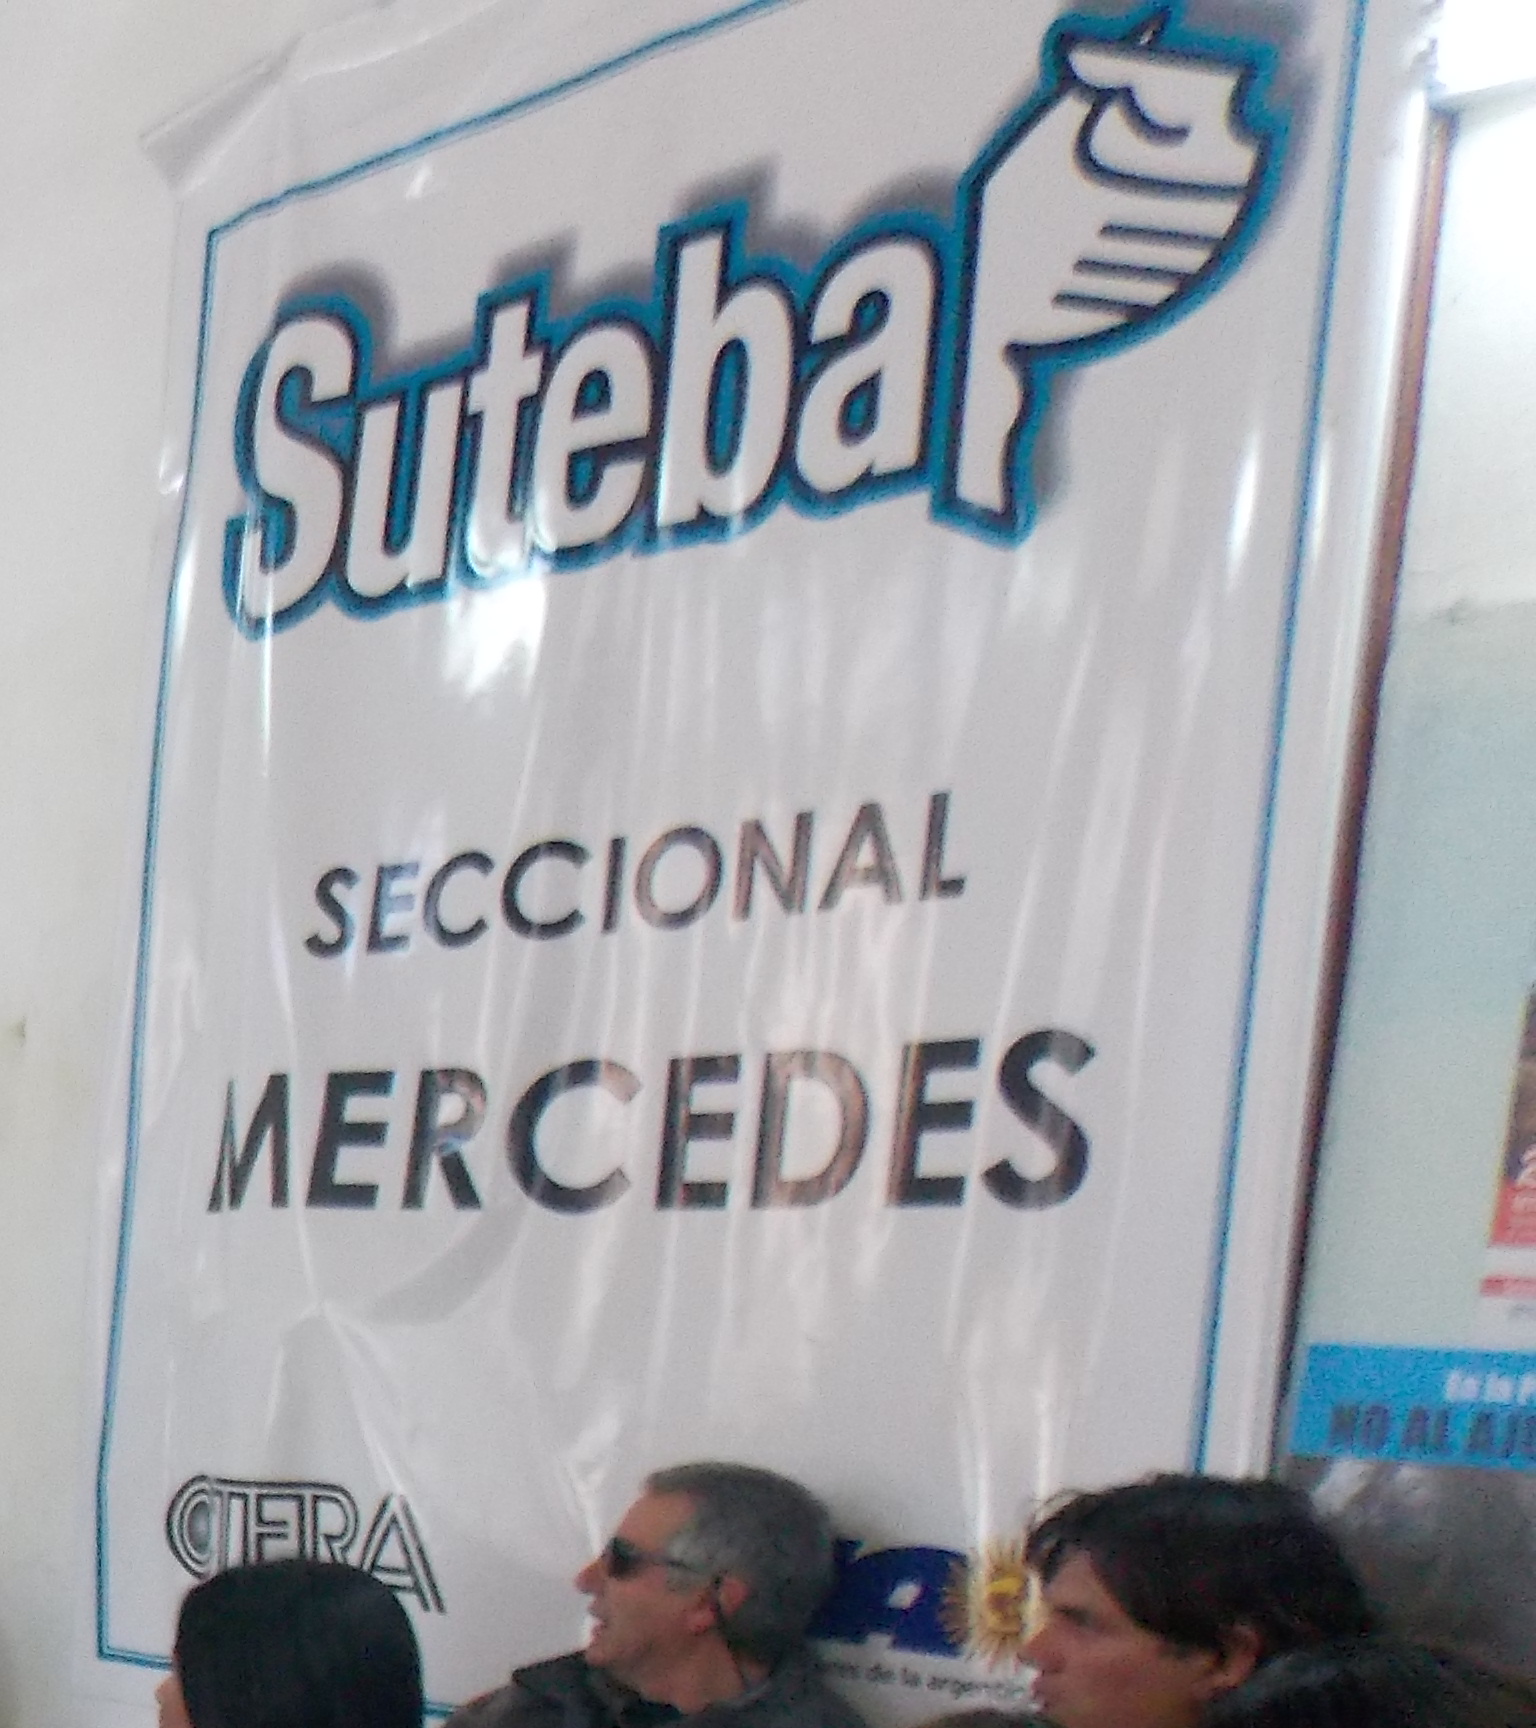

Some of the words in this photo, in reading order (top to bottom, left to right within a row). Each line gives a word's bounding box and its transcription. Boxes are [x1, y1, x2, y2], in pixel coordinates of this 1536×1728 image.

[228, 210, 940, 632] Suteba
[304, 790, 968, 958] SECCIONAL
[206, 1028, 1096, 1212] MERCEDES
[1329, 1404, 1389, 1449] NO
[1401, 1406, 1450, 1452] AL
